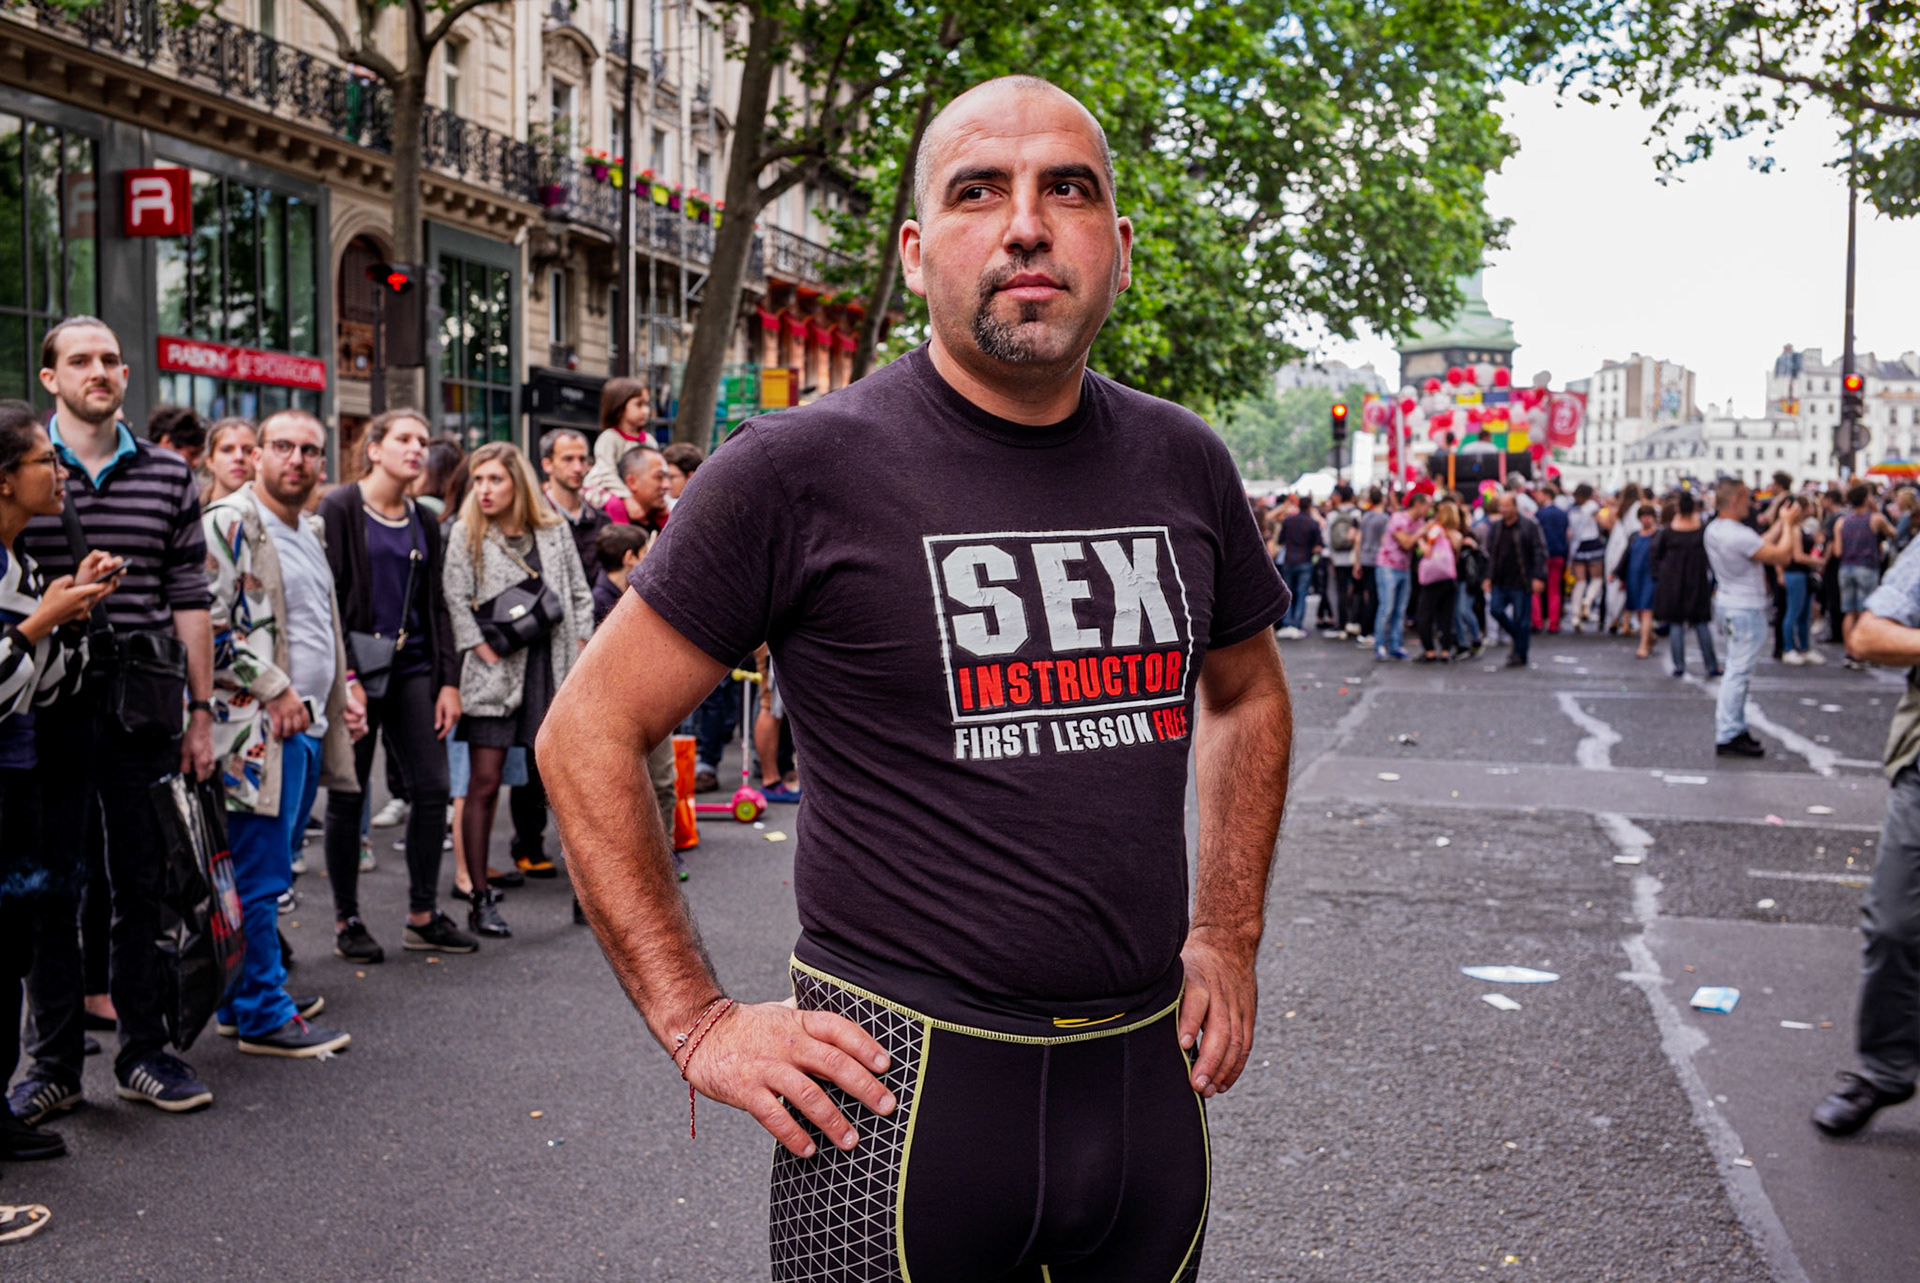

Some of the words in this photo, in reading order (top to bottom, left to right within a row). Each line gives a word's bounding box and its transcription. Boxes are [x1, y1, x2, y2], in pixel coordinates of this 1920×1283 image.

[941, 537, 1180, 656] SEX
[957, 650, 1182, 710] INSTRUCTOR
[954, 721, 1040, 760] FIRST
[1050, 711, 1154, 753] LESSON
[1152, 705, 1187, 742] FREE
